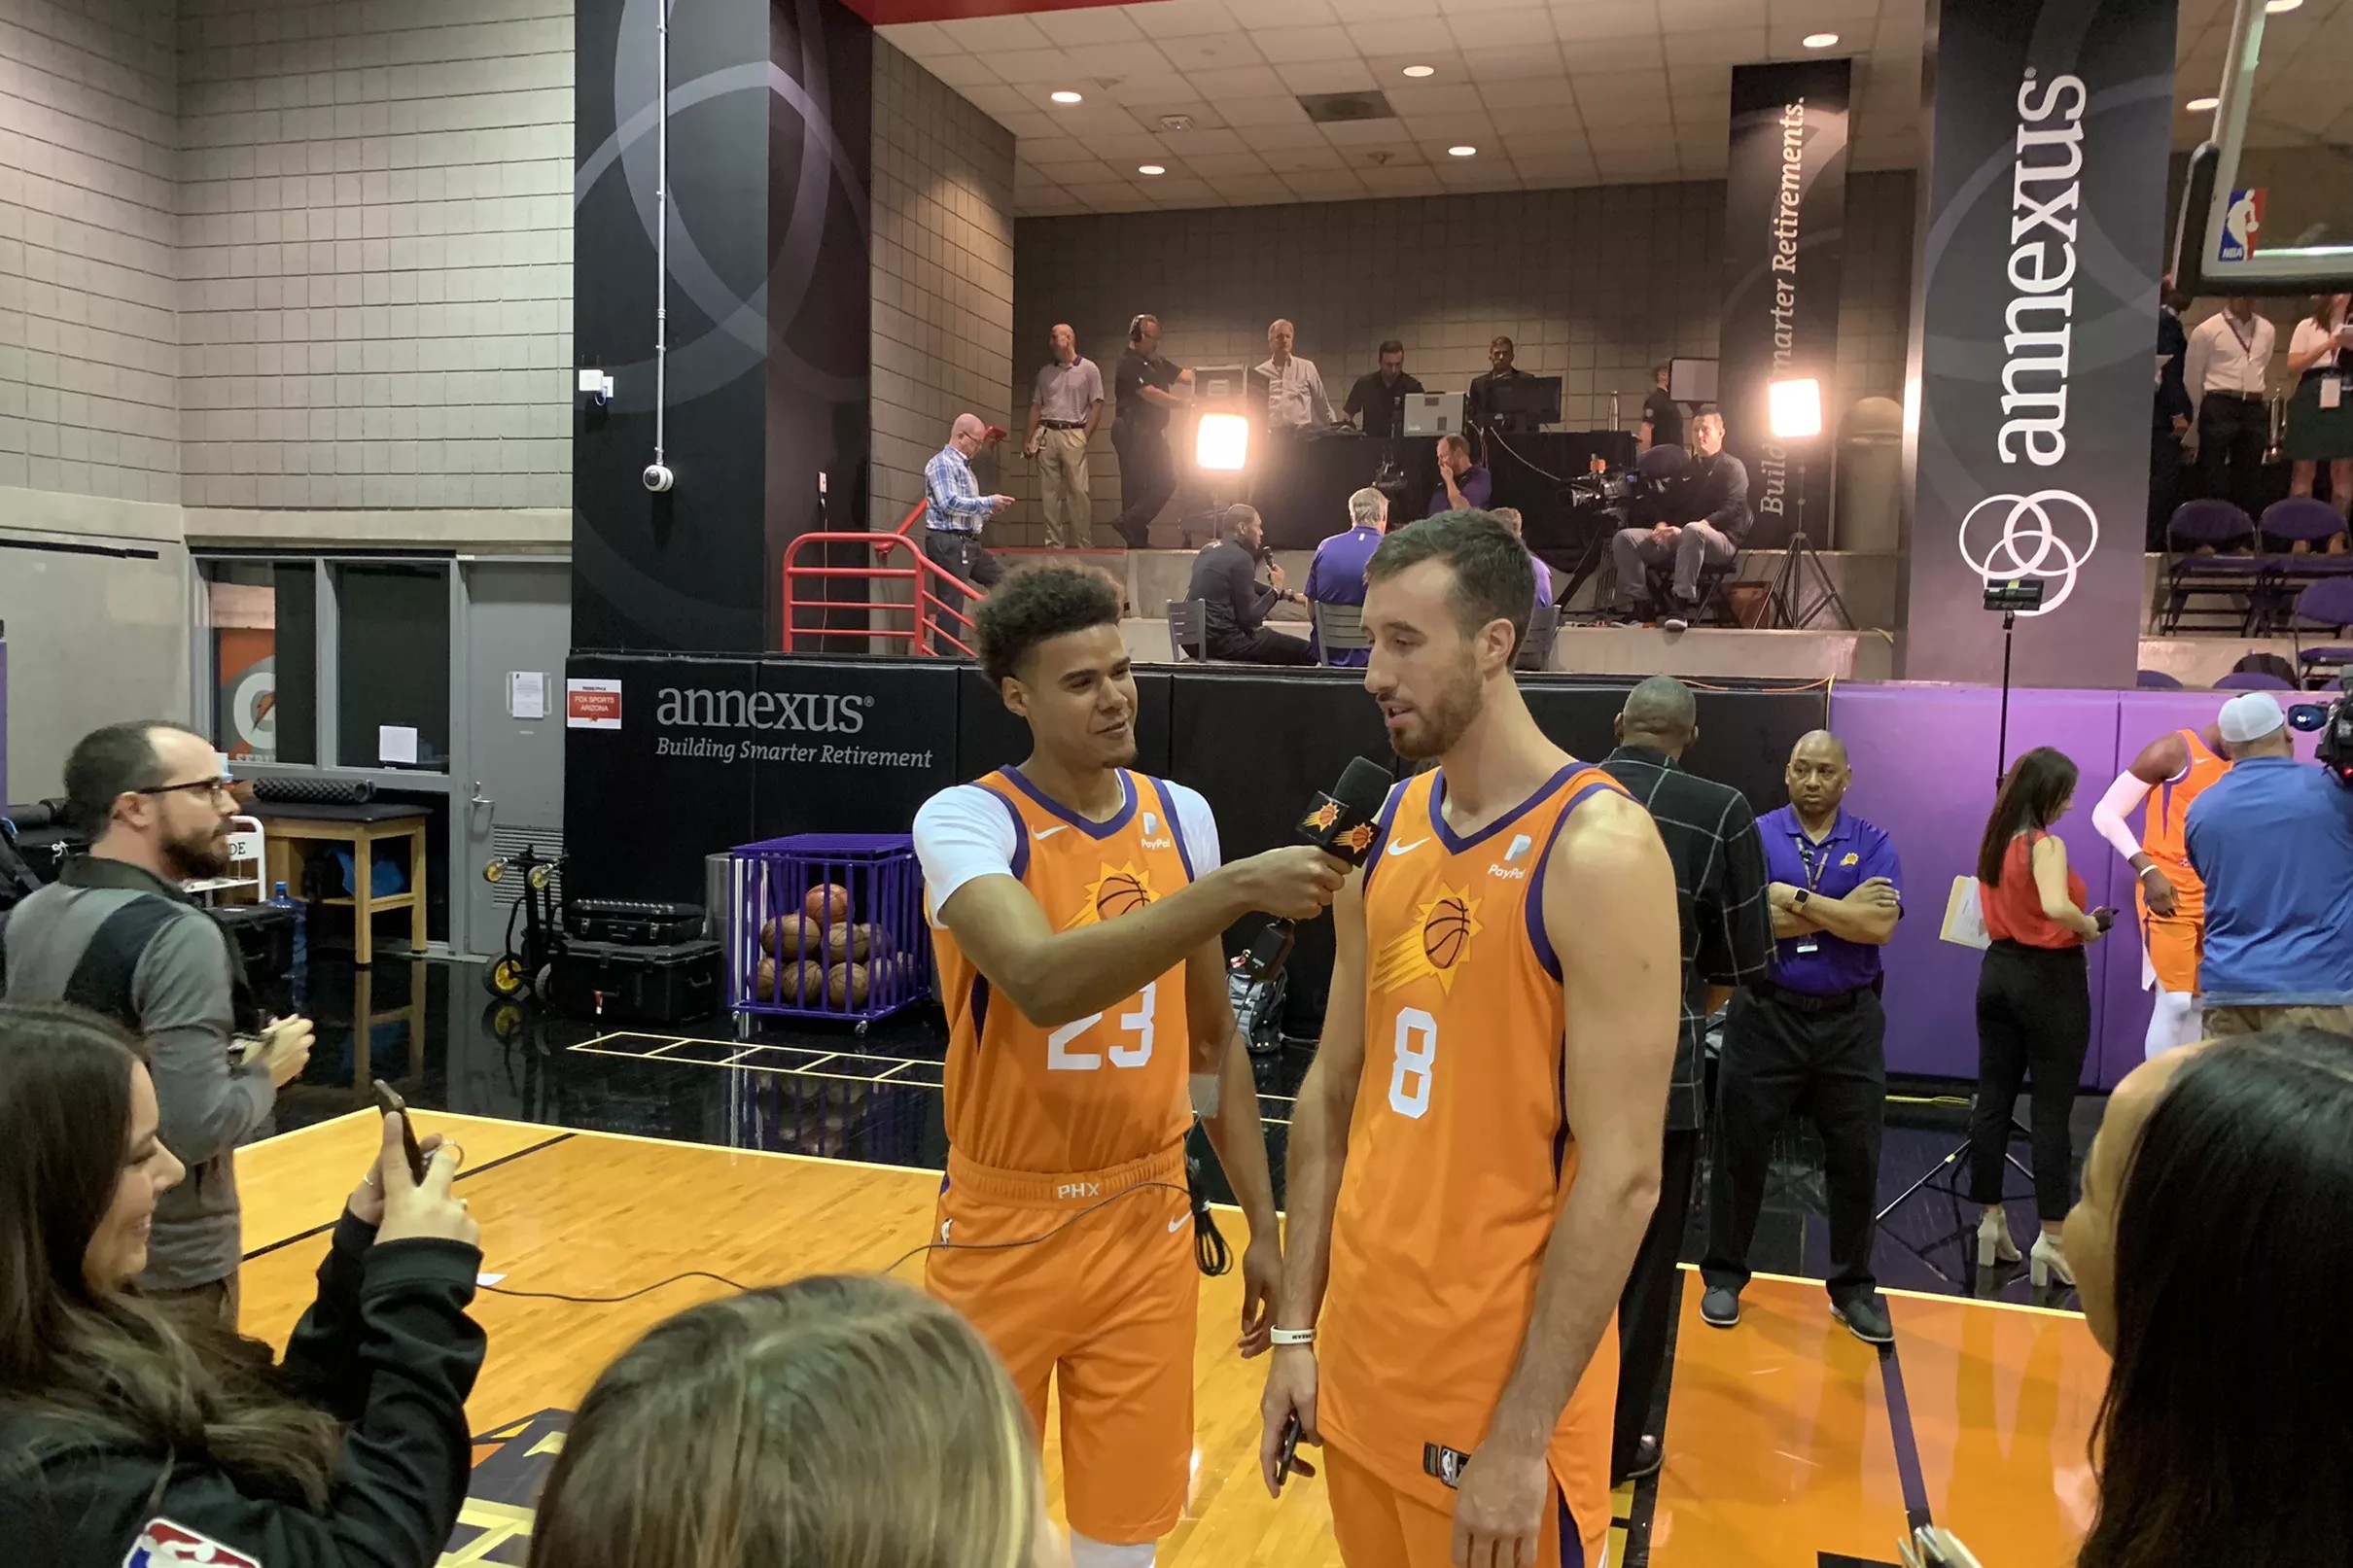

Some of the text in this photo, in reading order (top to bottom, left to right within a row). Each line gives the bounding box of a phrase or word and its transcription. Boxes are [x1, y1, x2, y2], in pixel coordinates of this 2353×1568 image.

[1760, 96, 1805, 516] Build marter Retirements.
[575, 695, 588, 704] FOX
[655, 737, 933, 768] Building Smarter Retirement
[1141, 838, 1171, 851] PayPal
[1488, 863, 1527, 880] PayPal
[1048, 981, 1156, 1070] 23
[1388, 1006, 1438, 1119] 8
[1057, 1182, 1100, 1199] PHX
